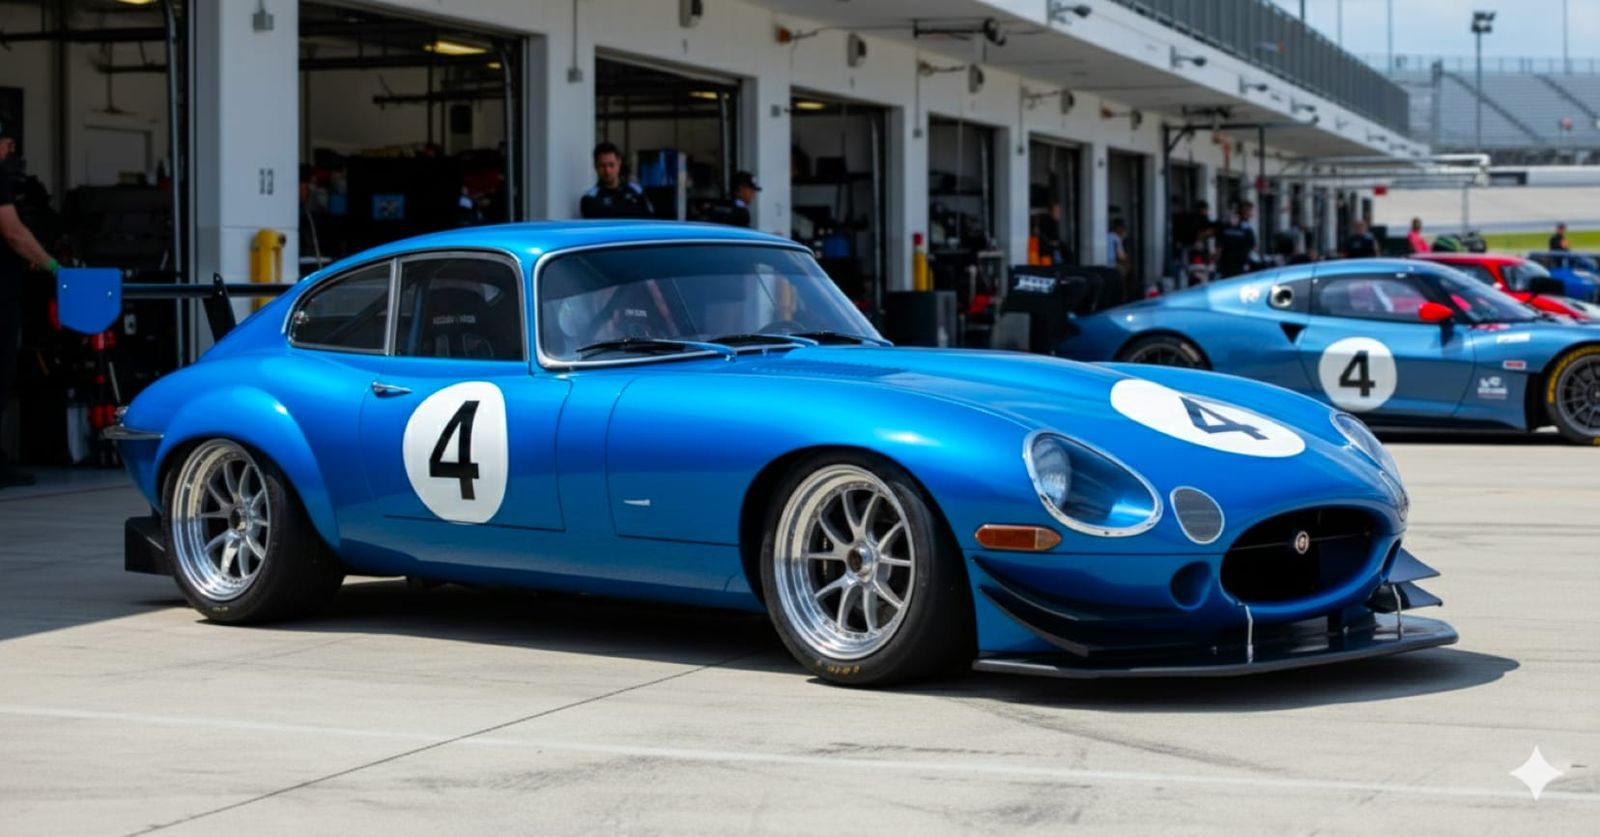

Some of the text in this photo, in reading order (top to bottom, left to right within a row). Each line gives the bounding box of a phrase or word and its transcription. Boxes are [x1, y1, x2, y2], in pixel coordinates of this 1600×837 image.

[1338, 351, 1376, 398] 4
[1179, 396, 1269, 441] 4
[428, 400, 480, 501] 4
